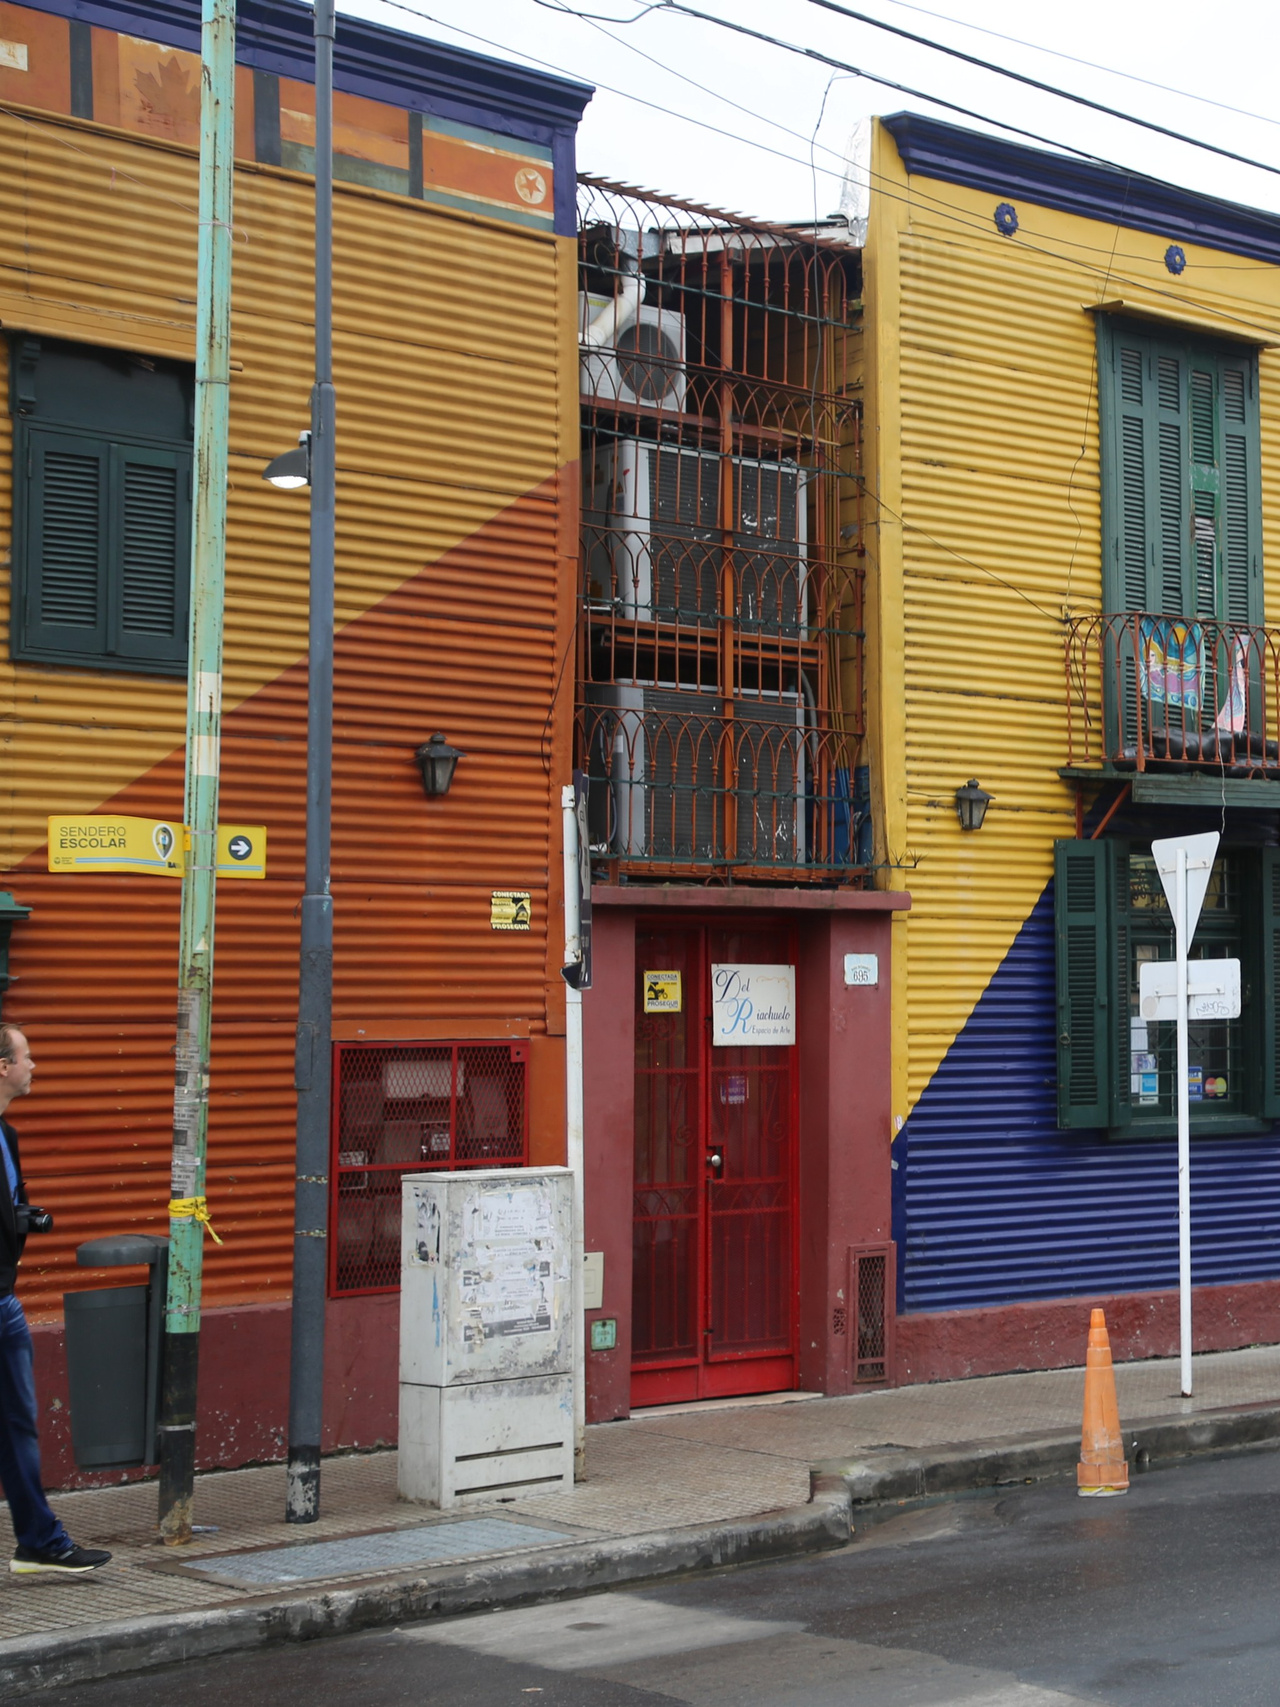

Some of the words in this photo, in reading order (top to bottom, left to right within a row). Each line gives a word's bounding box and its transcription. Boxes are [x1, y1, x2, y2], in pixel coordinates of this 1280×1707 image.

[59, 826, 126, 837] SENDERO
[59, 838, 126, 848] ESCOLAR
[853, 969, 869, 982] 695
[712, 968, 750, 1003] Del
[752, 1025, 771, 1036] Espacio
[773, 1025, 779, 1034] de
[780, 1025, 790, 1034] Arte
